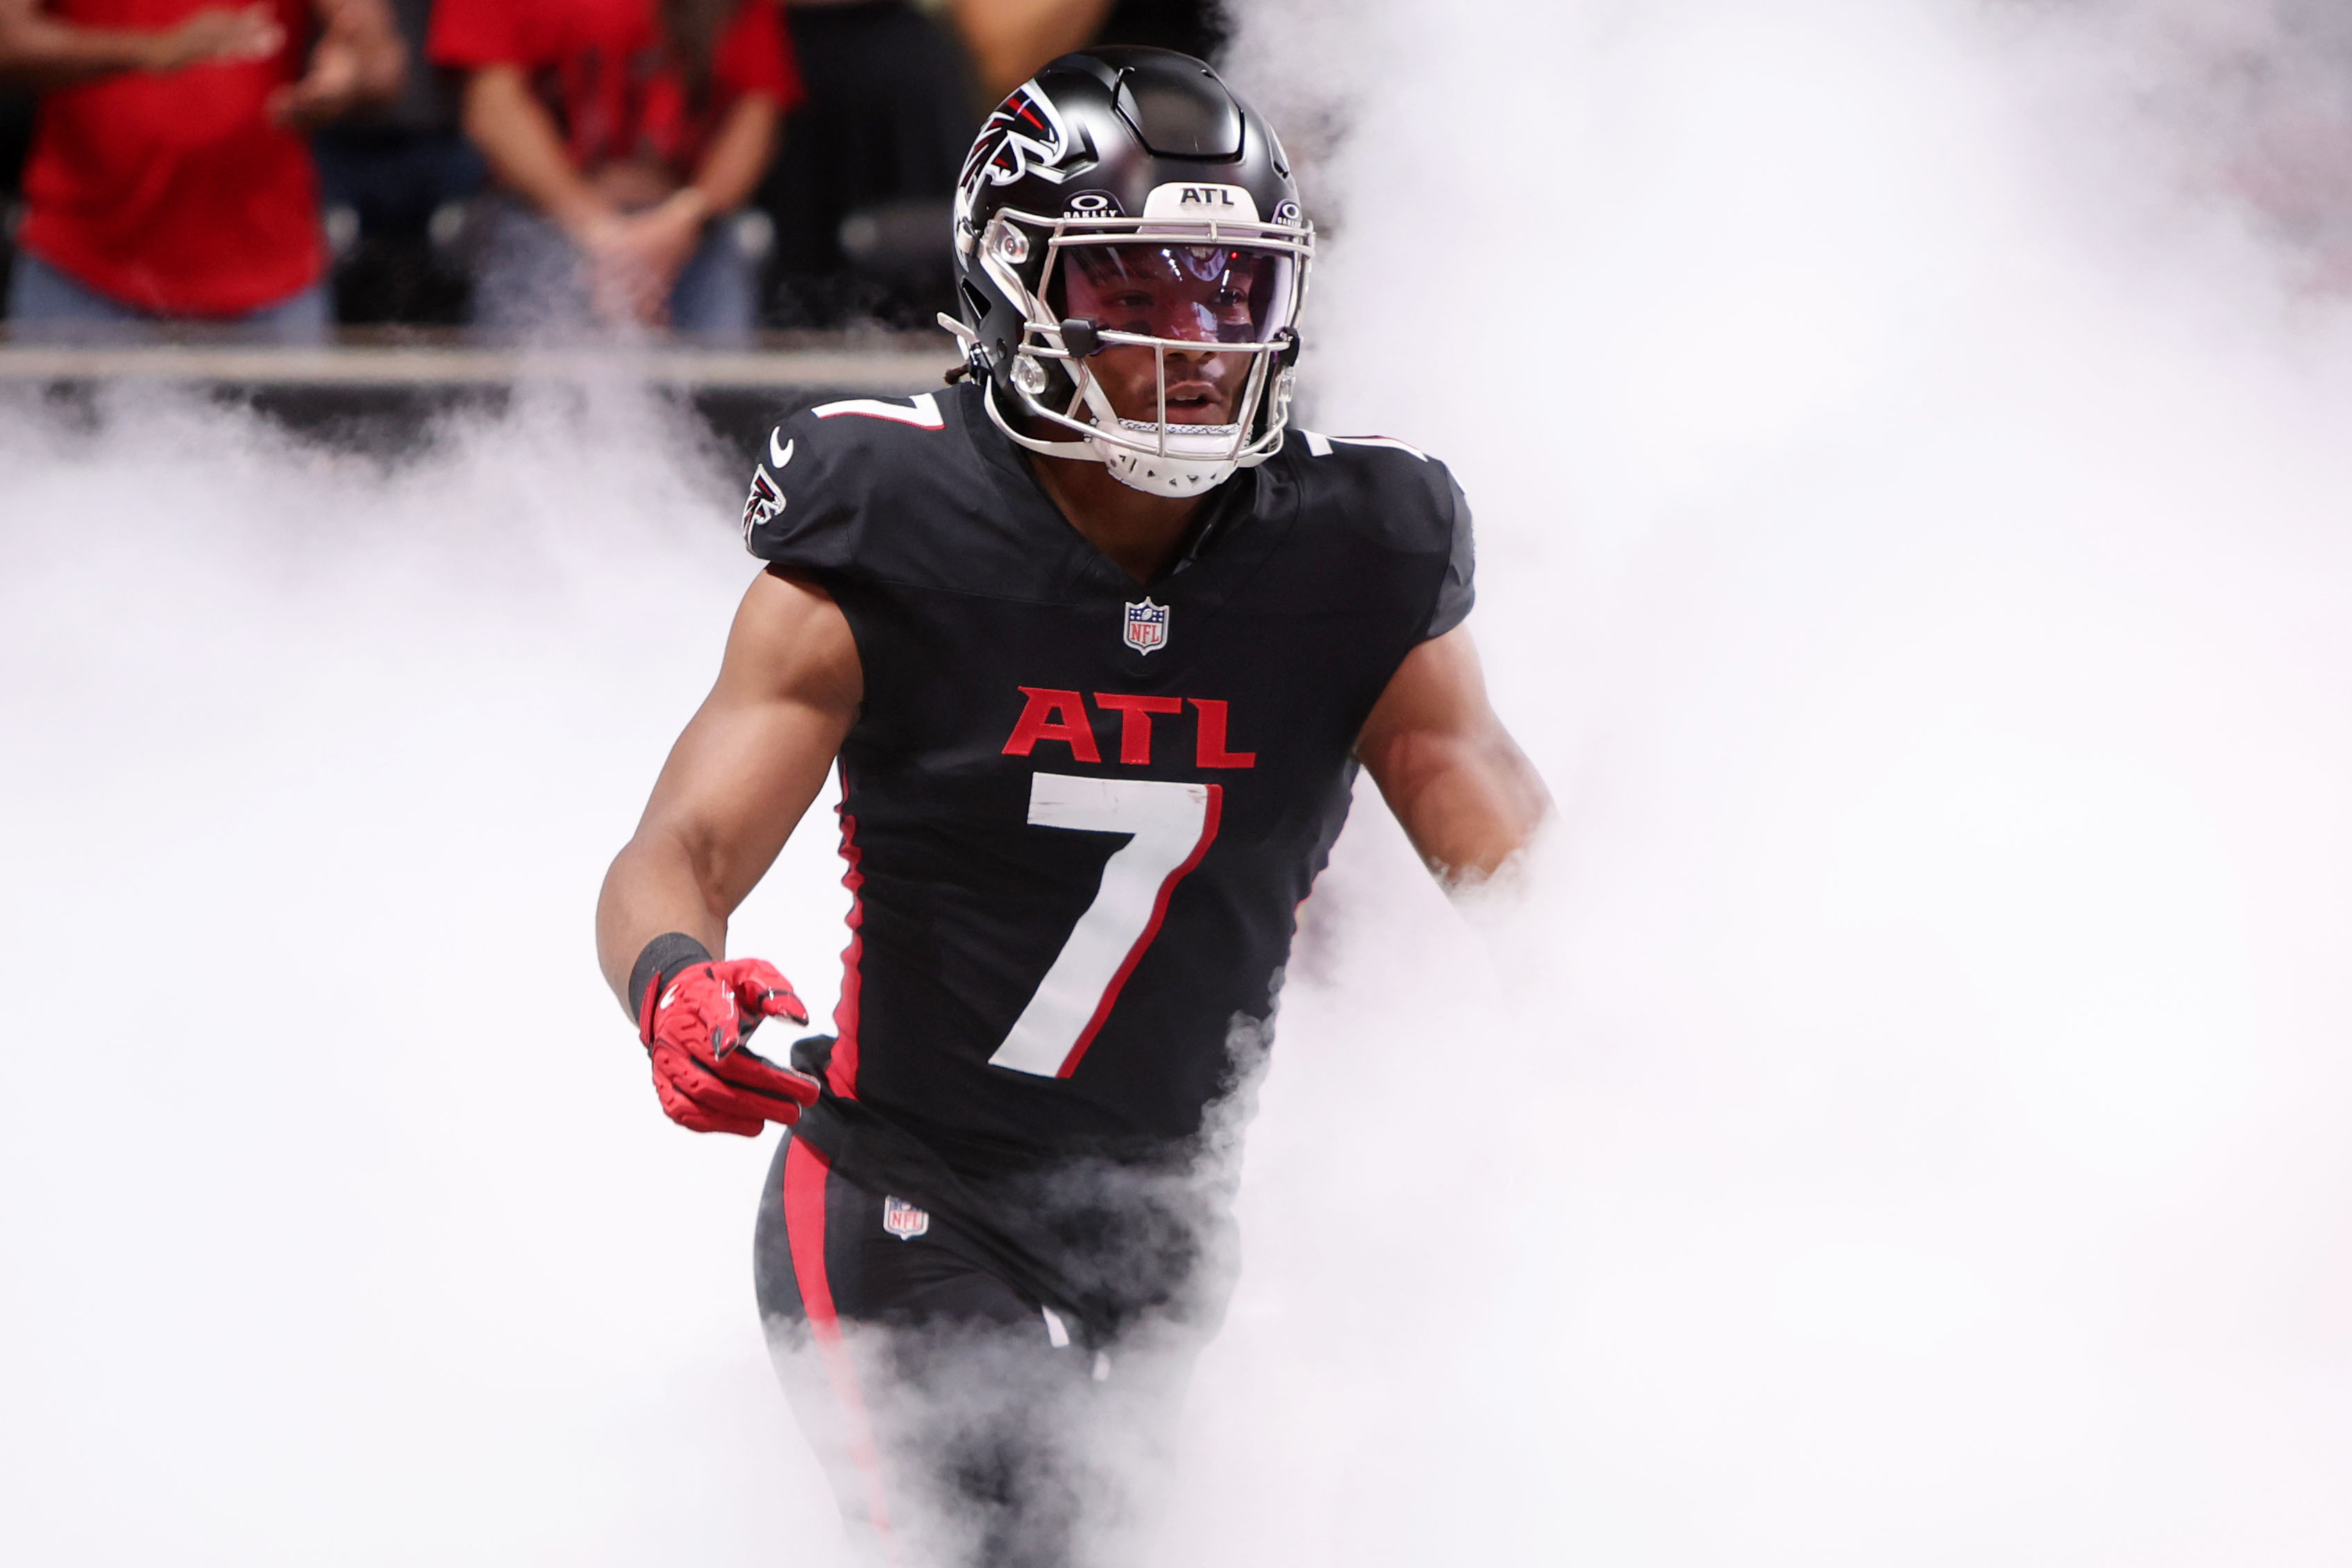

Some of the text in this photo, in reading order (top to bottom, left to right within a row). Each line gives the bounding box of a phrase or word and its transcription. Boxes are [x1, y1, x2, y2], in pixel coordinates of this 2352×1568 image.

[1180, 187, 1235, 206] ATL
[1063, 209, 1118, 219] OAKLEY
[1129, 623, 1160, 646] NFL
[1001, 685, 1257, 768] ATL
[987, 770, 1223, 1079] 7
[891, 1211, 923, 1231] NFL
